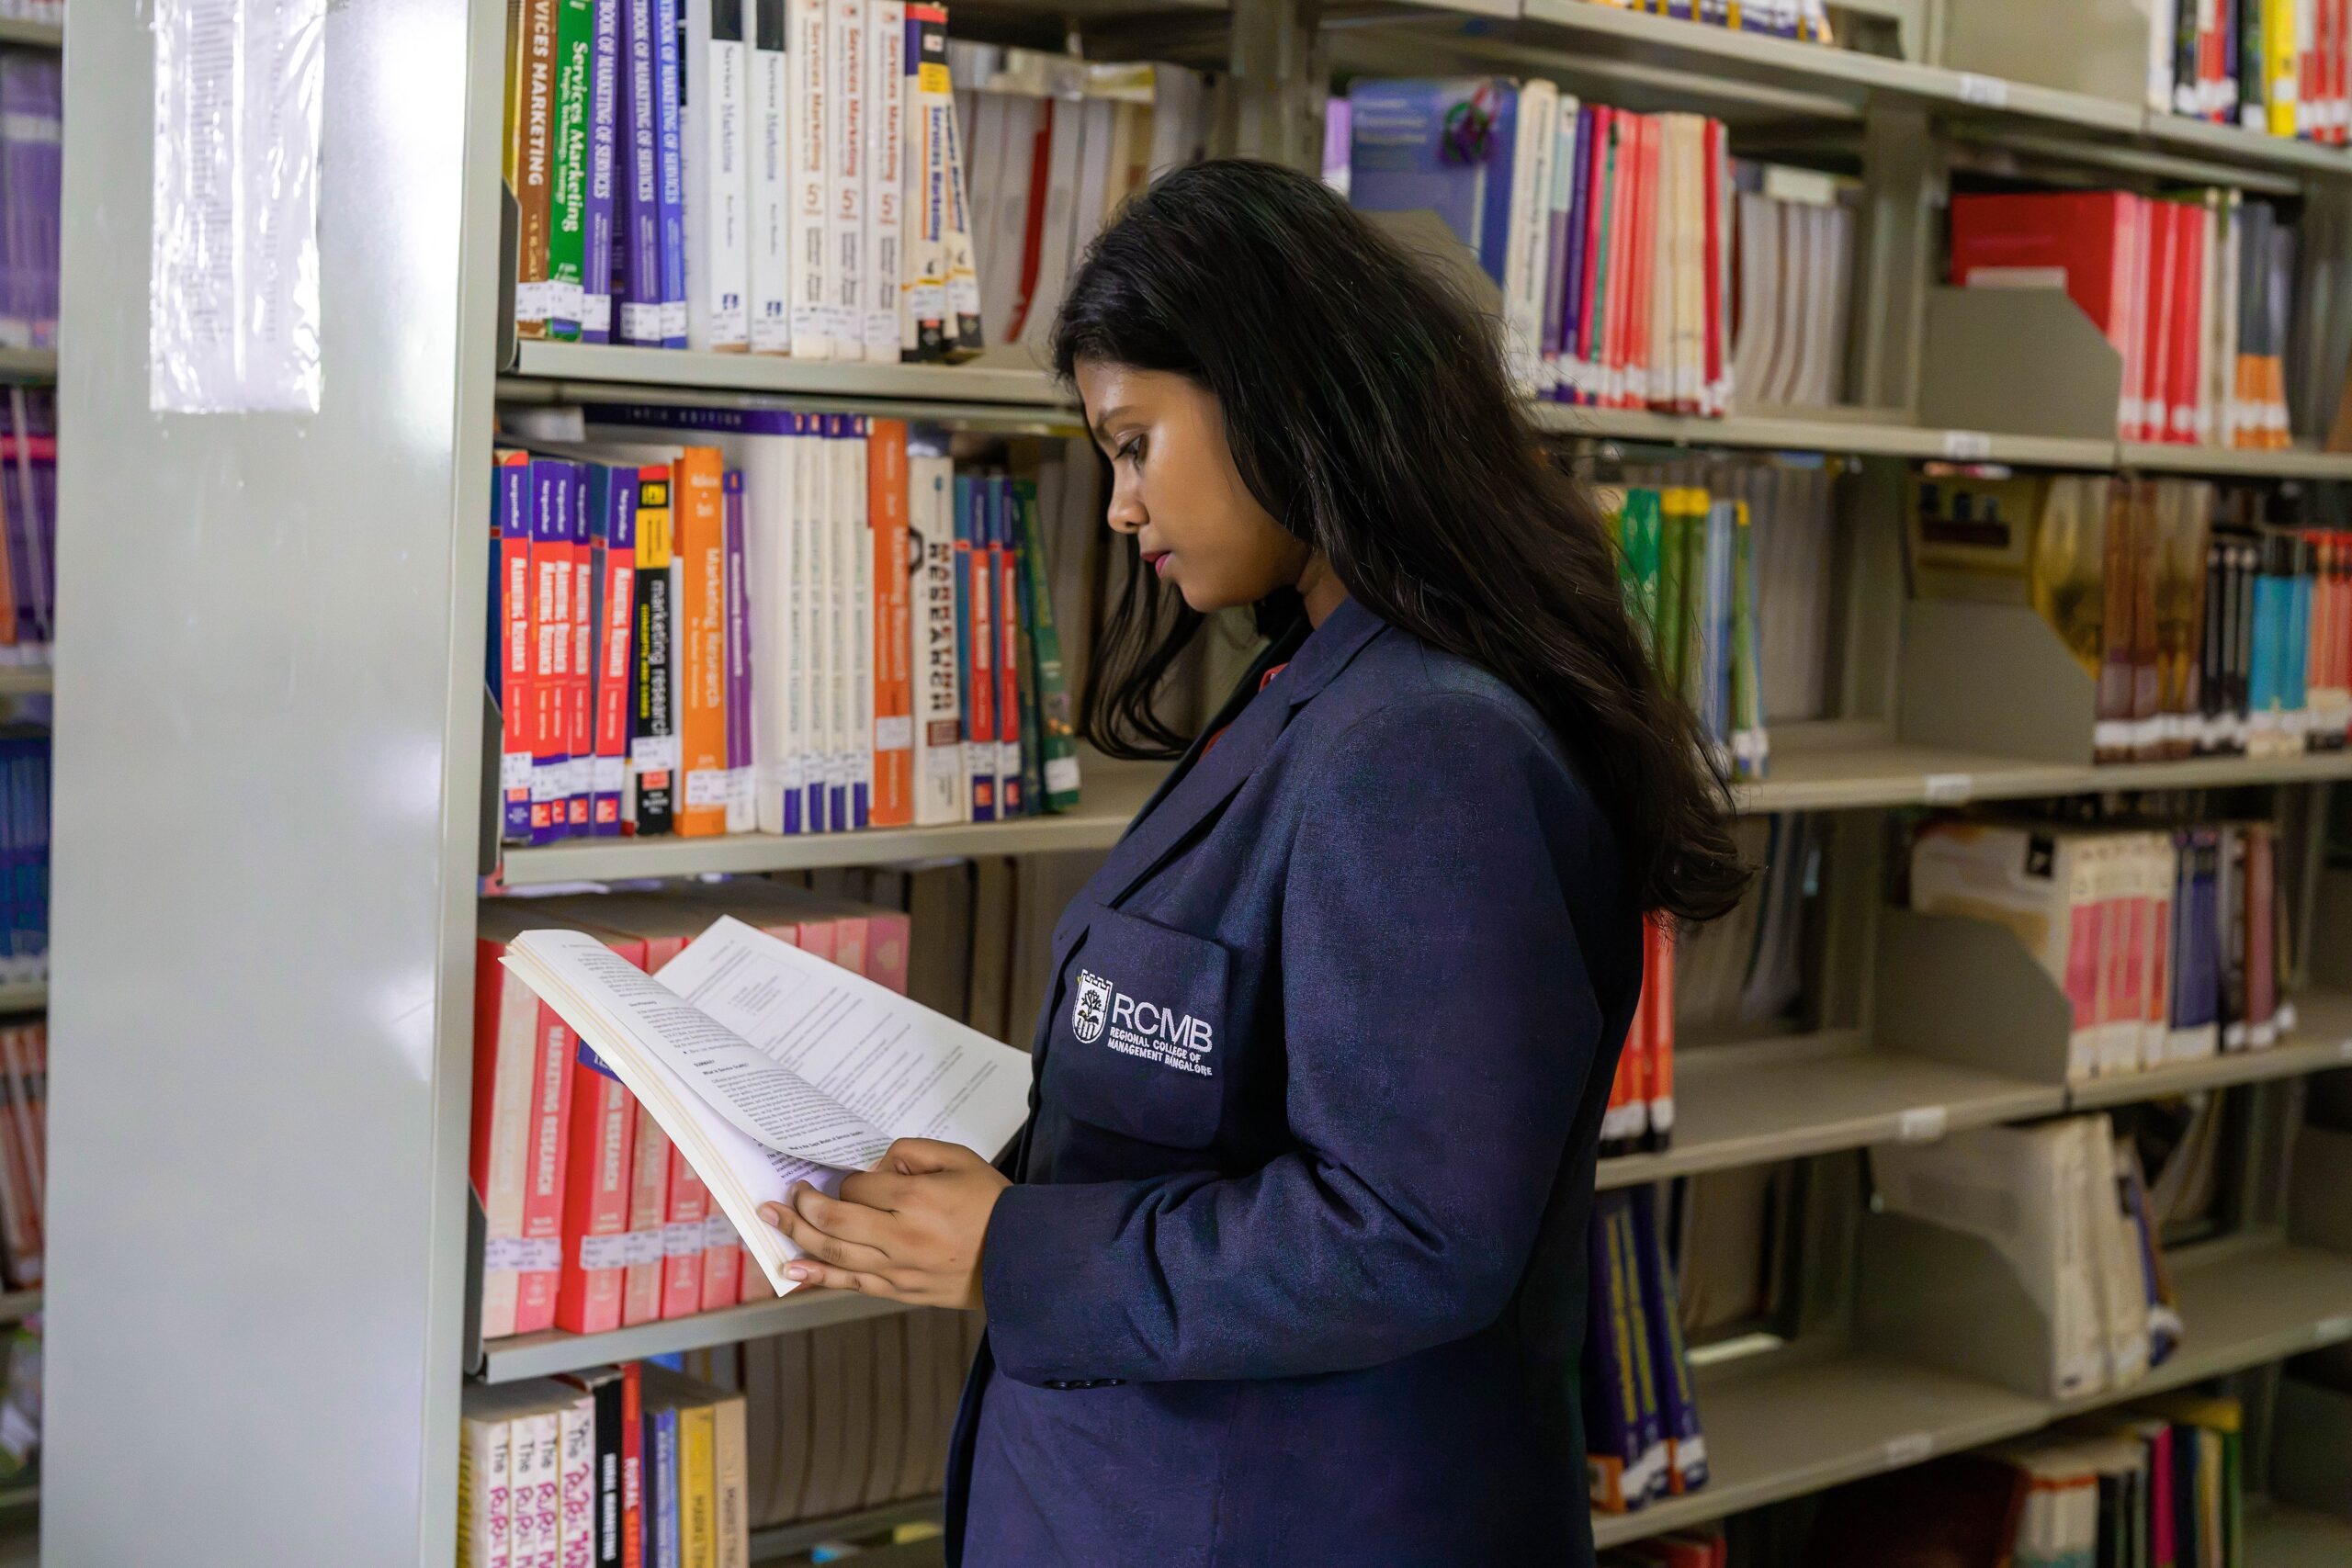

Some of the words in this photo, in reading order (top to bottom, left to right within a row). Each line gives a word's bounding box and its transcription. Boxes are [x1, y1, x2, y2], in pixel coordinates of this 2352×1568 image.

[597, 36, 615, 55] OF
[634, 41, 649, 57] OF
[570, 40, 589, 124] Services
[595, 56, 614, 124] MARKETING
[528, 62, 548, 186] MARKETING
[594, 125, 612, 143] OF
[561, 129, 584, 232] Marketing
[703, 547, 720, 629] Marketing
[648, 580, 670, 665] marketing
[928, 542, 942, 711] RESEARCH
[705, 631, 723, 708] Research
[1109, 1026, 1150, 1048] REGIONAL
[1152, 1039, 1187, 1060] COLLEGE
[1189, 1051, 1202, 1064] OF
[1112, 993, 1212, 1052] RCMB
[1107, 1038, 1162, 1060] MANAGEMENT
[1165, 1056, 1212, 1076] BANGALORE
[493, 1439, 510, 1473] The
[519, 1440, 535, 1472] The
[541, 1436, 560, 1469] The
